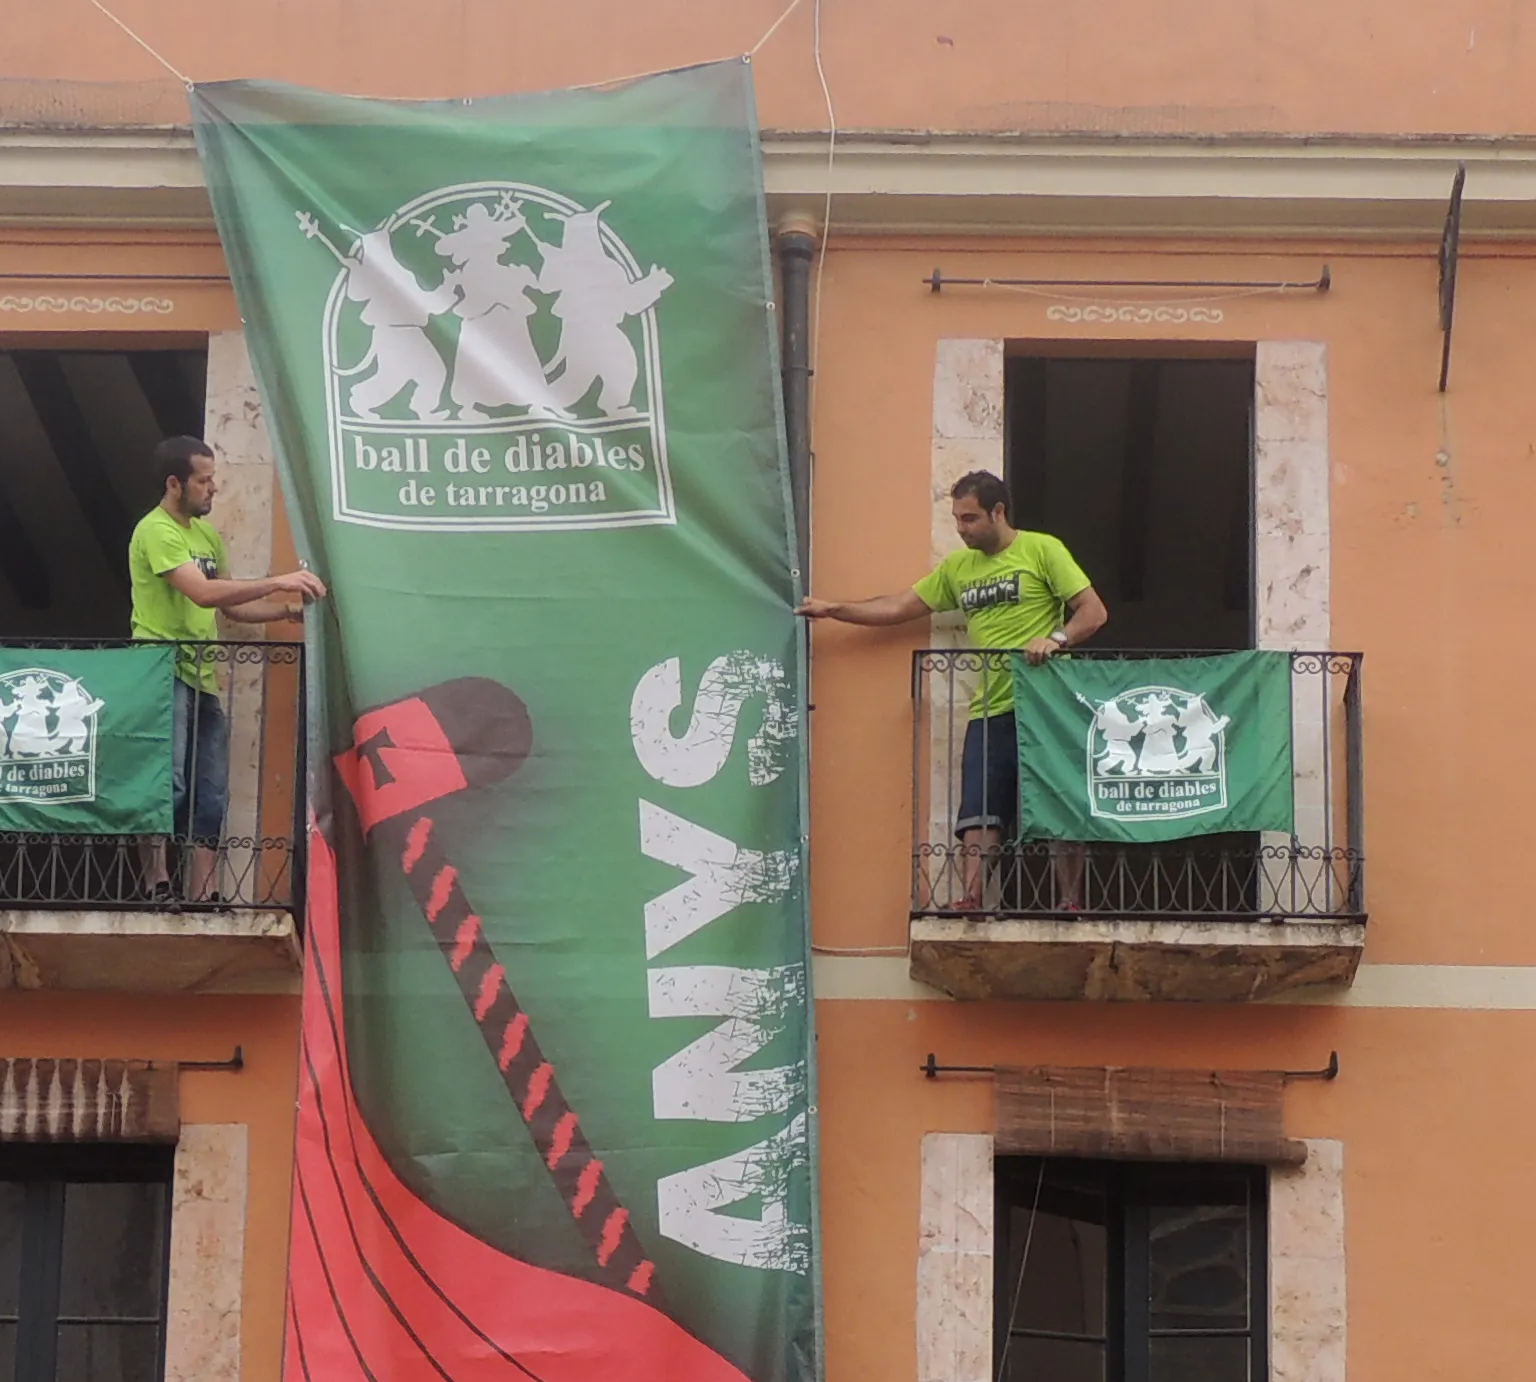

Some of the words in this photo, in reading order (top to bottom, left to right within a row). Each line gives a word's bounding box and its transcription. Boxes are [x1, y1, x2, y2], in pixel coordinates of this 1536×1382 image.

[354, 435, 430, 473] ball
[444, 437, 491, 473] de
[504, 434, 646, 473] diables
[399, 479, 437, 506] de
[445, 479, 606, 512] tarragona
[7, 764, 26, 782] de
[30, 762, 86, 780] diables
[5, 783, 68, 797] tarragona
[1098, 782, 1130, 800] ball
[1134, 782, 1155, 799] de
[1158, 780, 1217, 798] diables
[1116, 799, 1133, 812] de
[1136, 798, 1201, 812] tarragona
[629, 648, 807, 1277] ANYS
